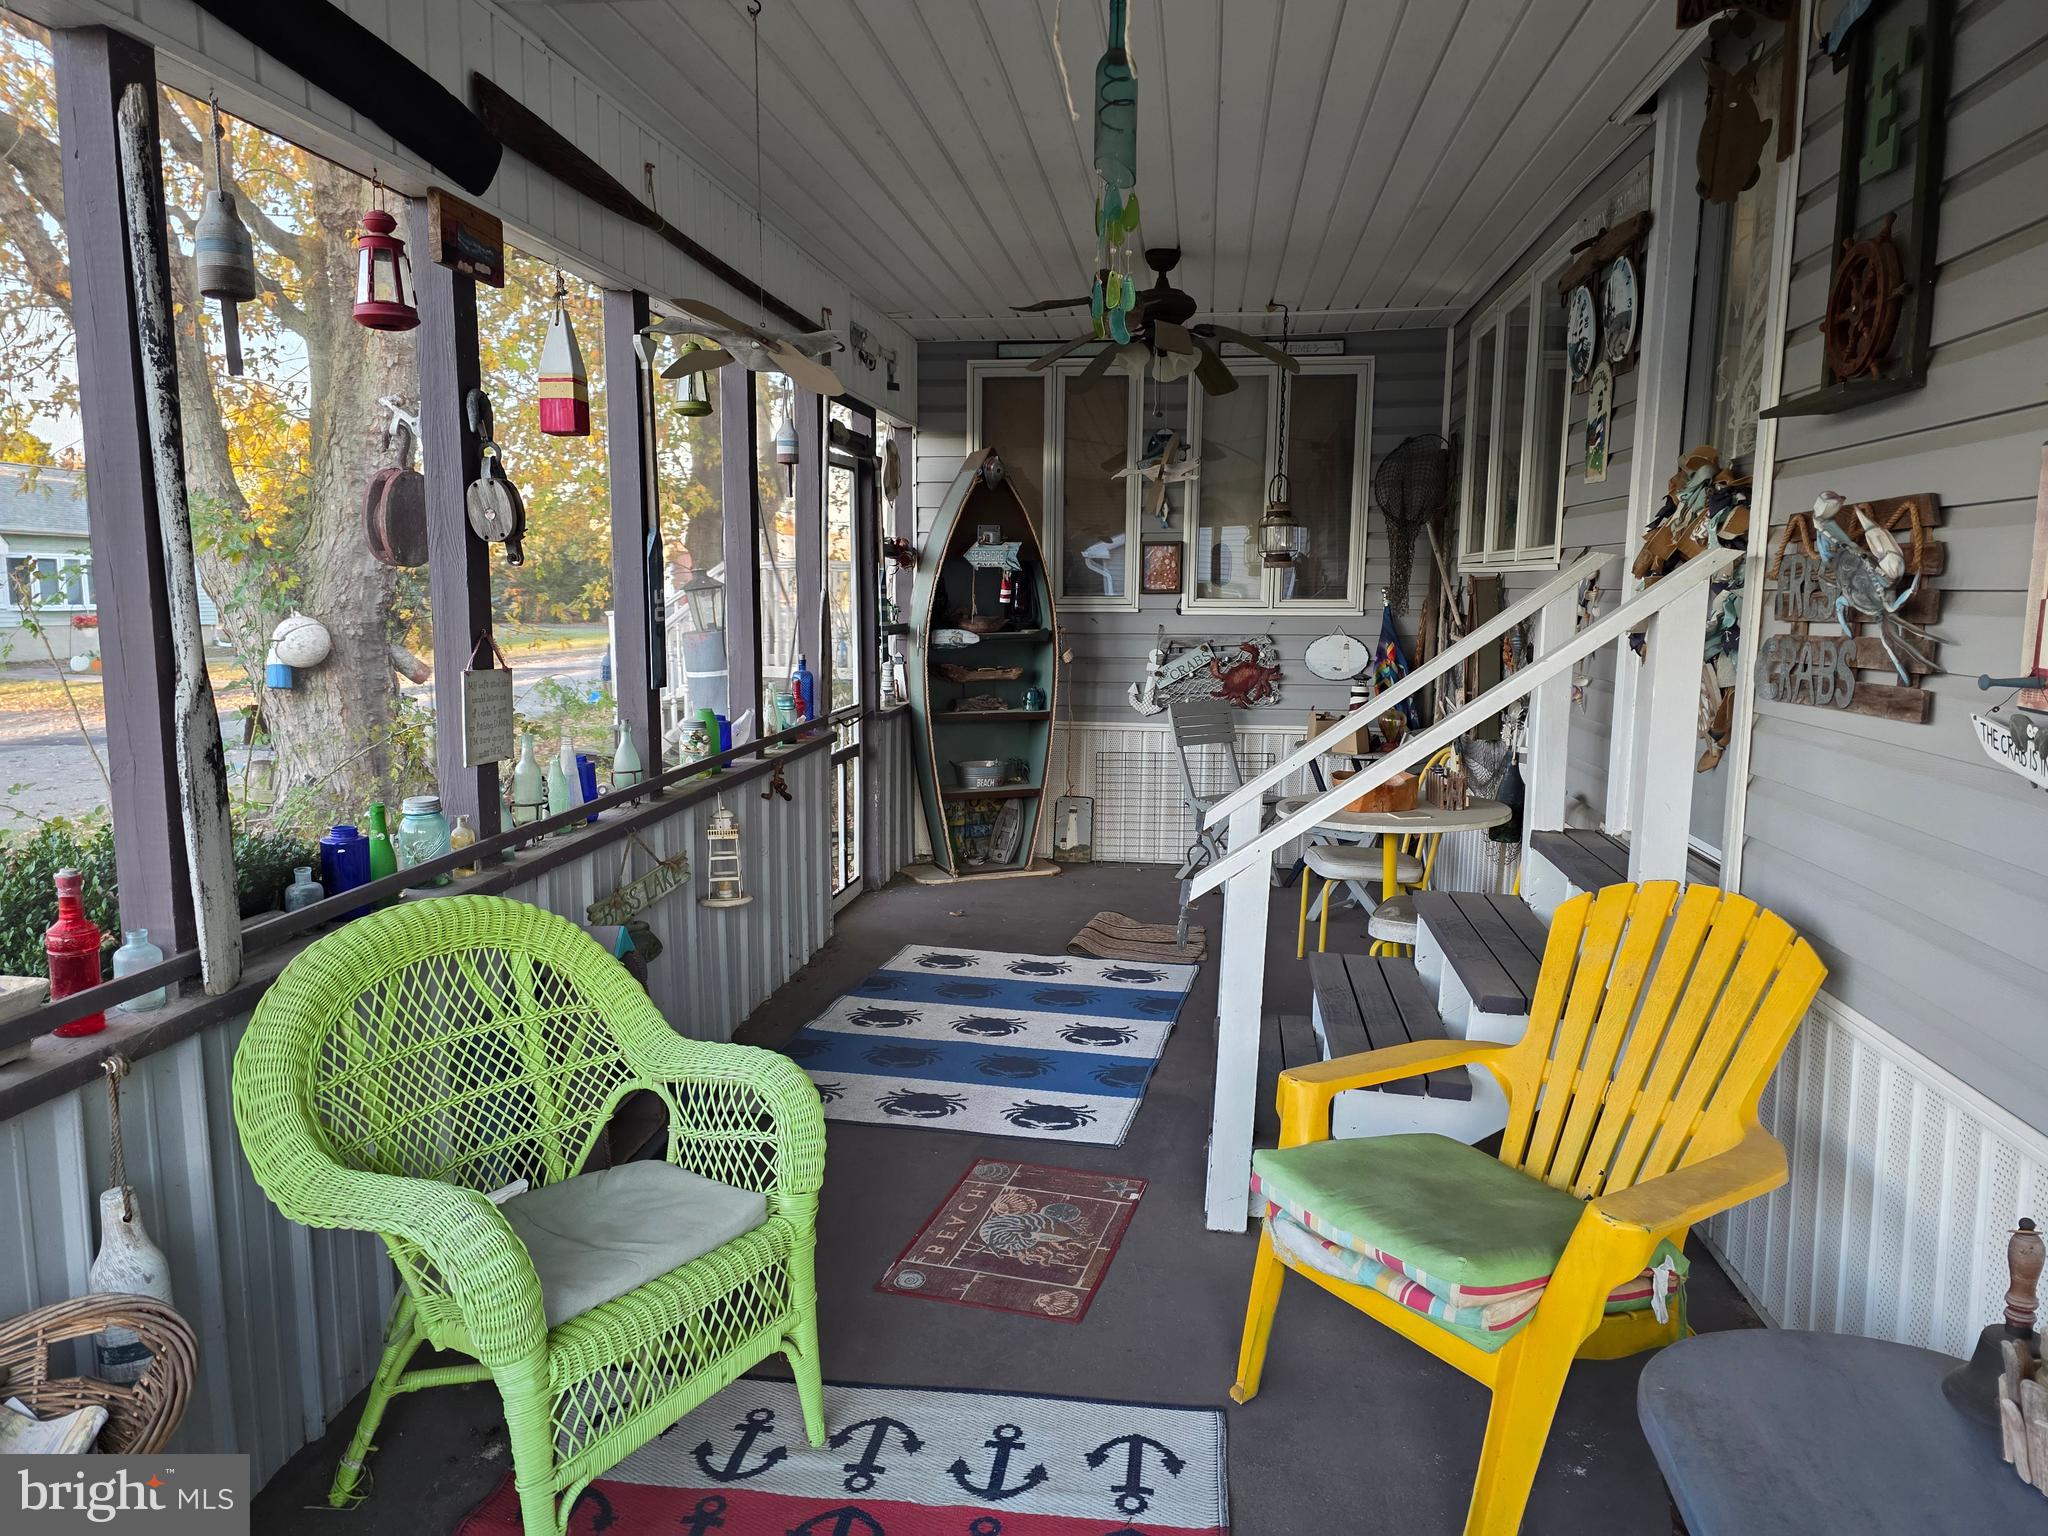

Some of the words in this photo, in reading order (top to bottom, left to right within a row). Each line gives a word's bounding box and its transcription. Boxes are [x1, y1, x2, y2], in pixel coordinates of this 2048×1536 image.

[1170, 651, 1211, 680] CRABS
[1754, 639, 1857, 709] CRABS
[1980, 722, 1999, 751] THE
[2029, 748, 2038, 772] IS
[976, 778, 995, 788] BEACH
[925, 1189, 987, 1255] BEACH
